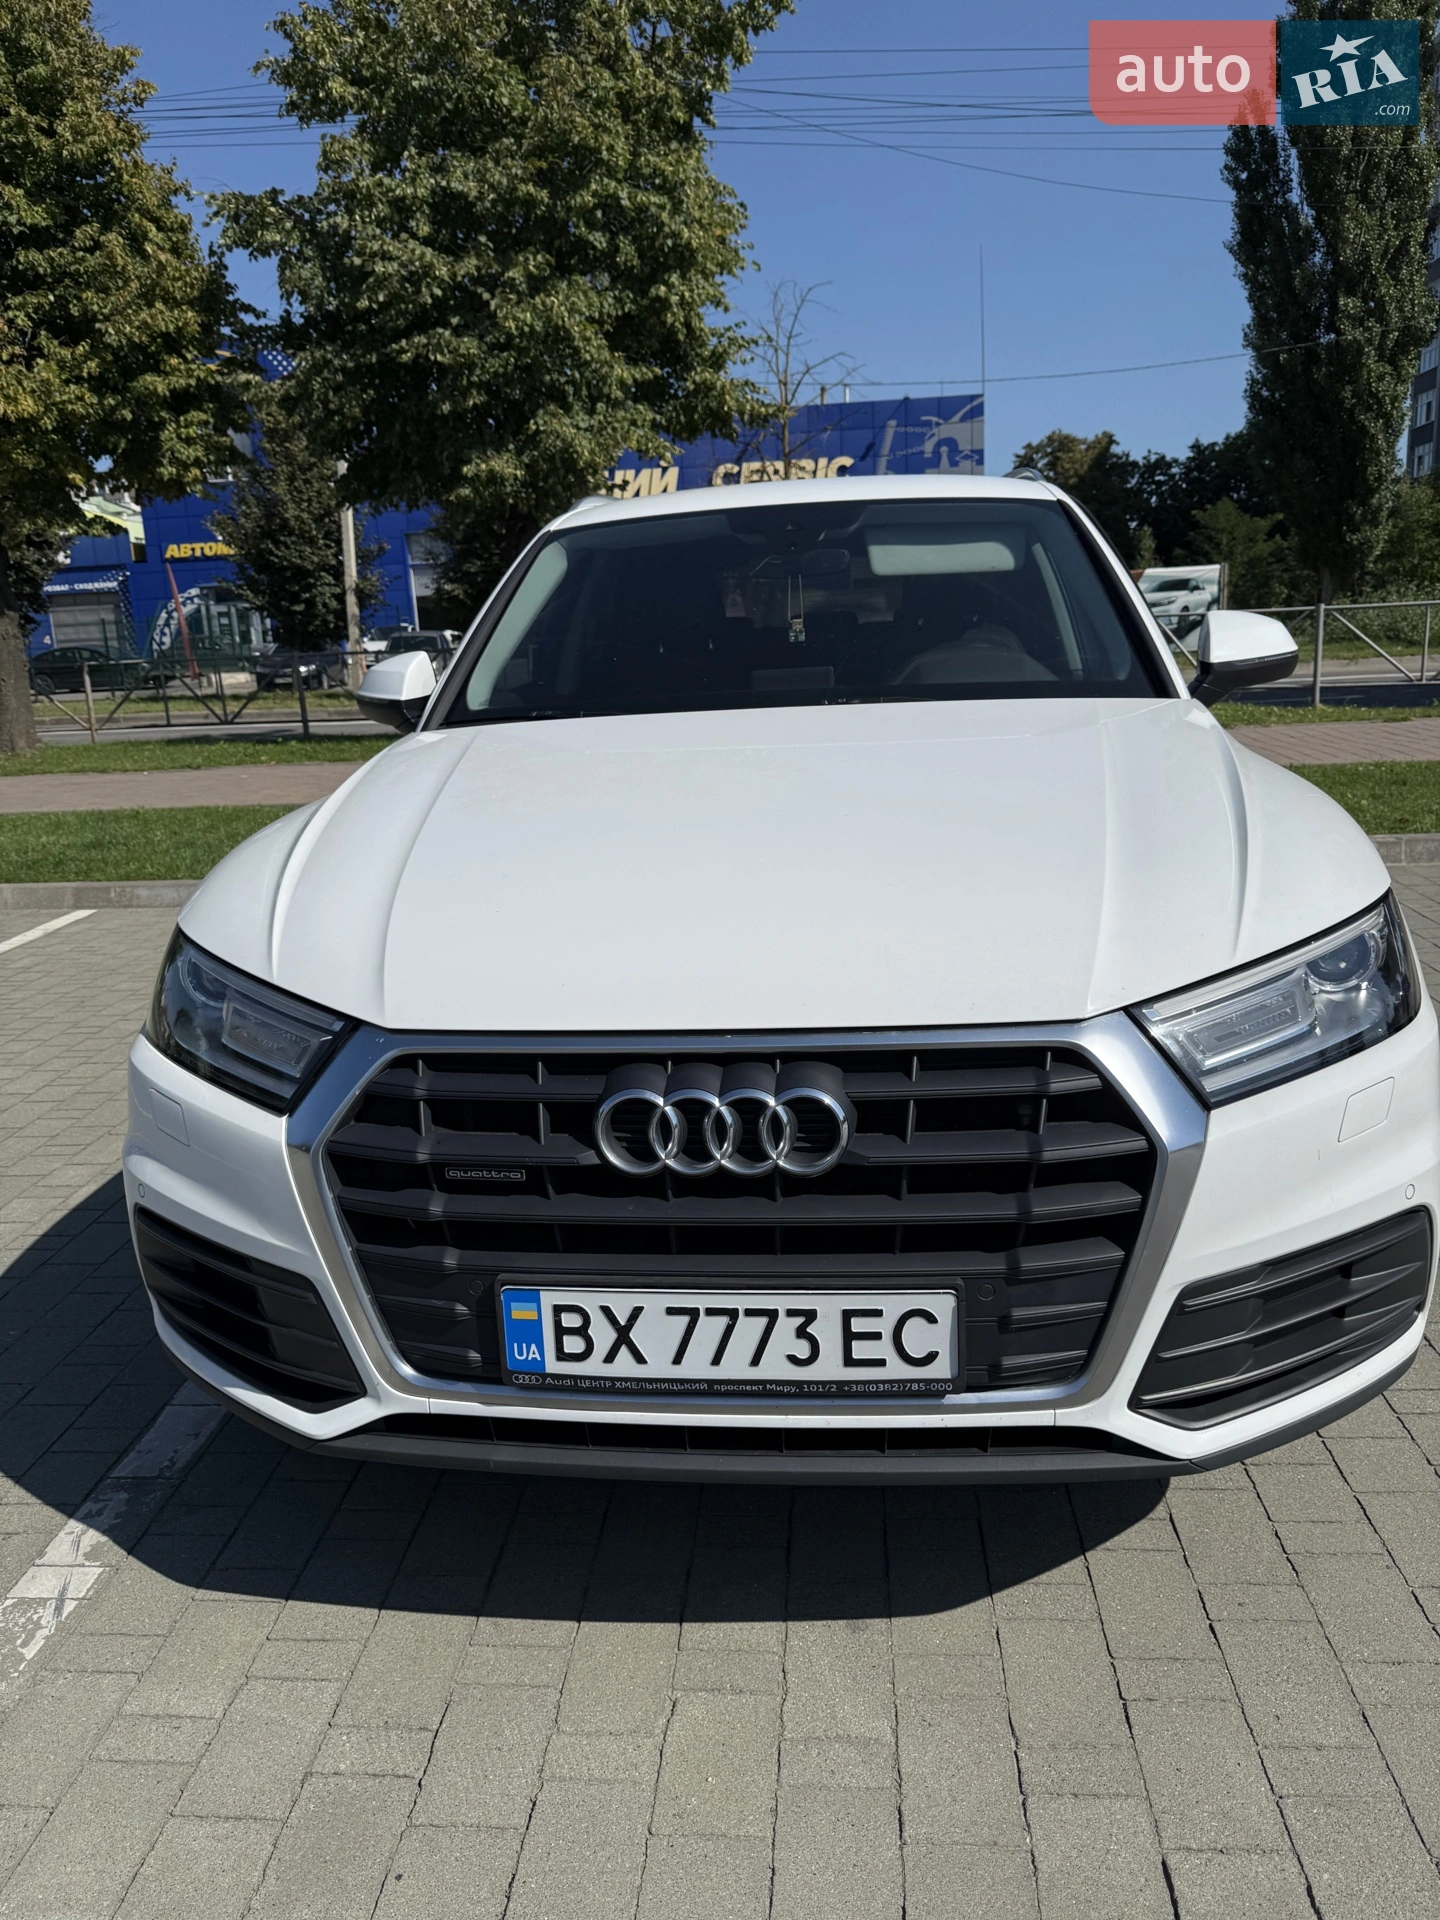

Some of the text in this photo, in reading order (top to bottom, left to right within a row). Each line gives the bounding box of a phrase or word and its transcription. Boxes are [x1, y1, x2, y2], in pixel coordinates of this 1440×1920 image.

[597, 460, 679, 499] НИЙ
[448, 1170, 522, 1178] quattro
[552, 1303, 939, 1367] BX 7773 EC
[513, 1343, 541, 1361] UA
[545, 1377, 574, 1386] Audi
[577, 1380, 612, 1389] ЦЕНТР
[614, 1381, 708, 1391] ХМЕЛЬНИЦЬКИЙ
[714, 1383, 763, 1392] проспект
[766, 1383, 799, 1393] Миру,
[802, 1383, 837, 1392] 101/2
